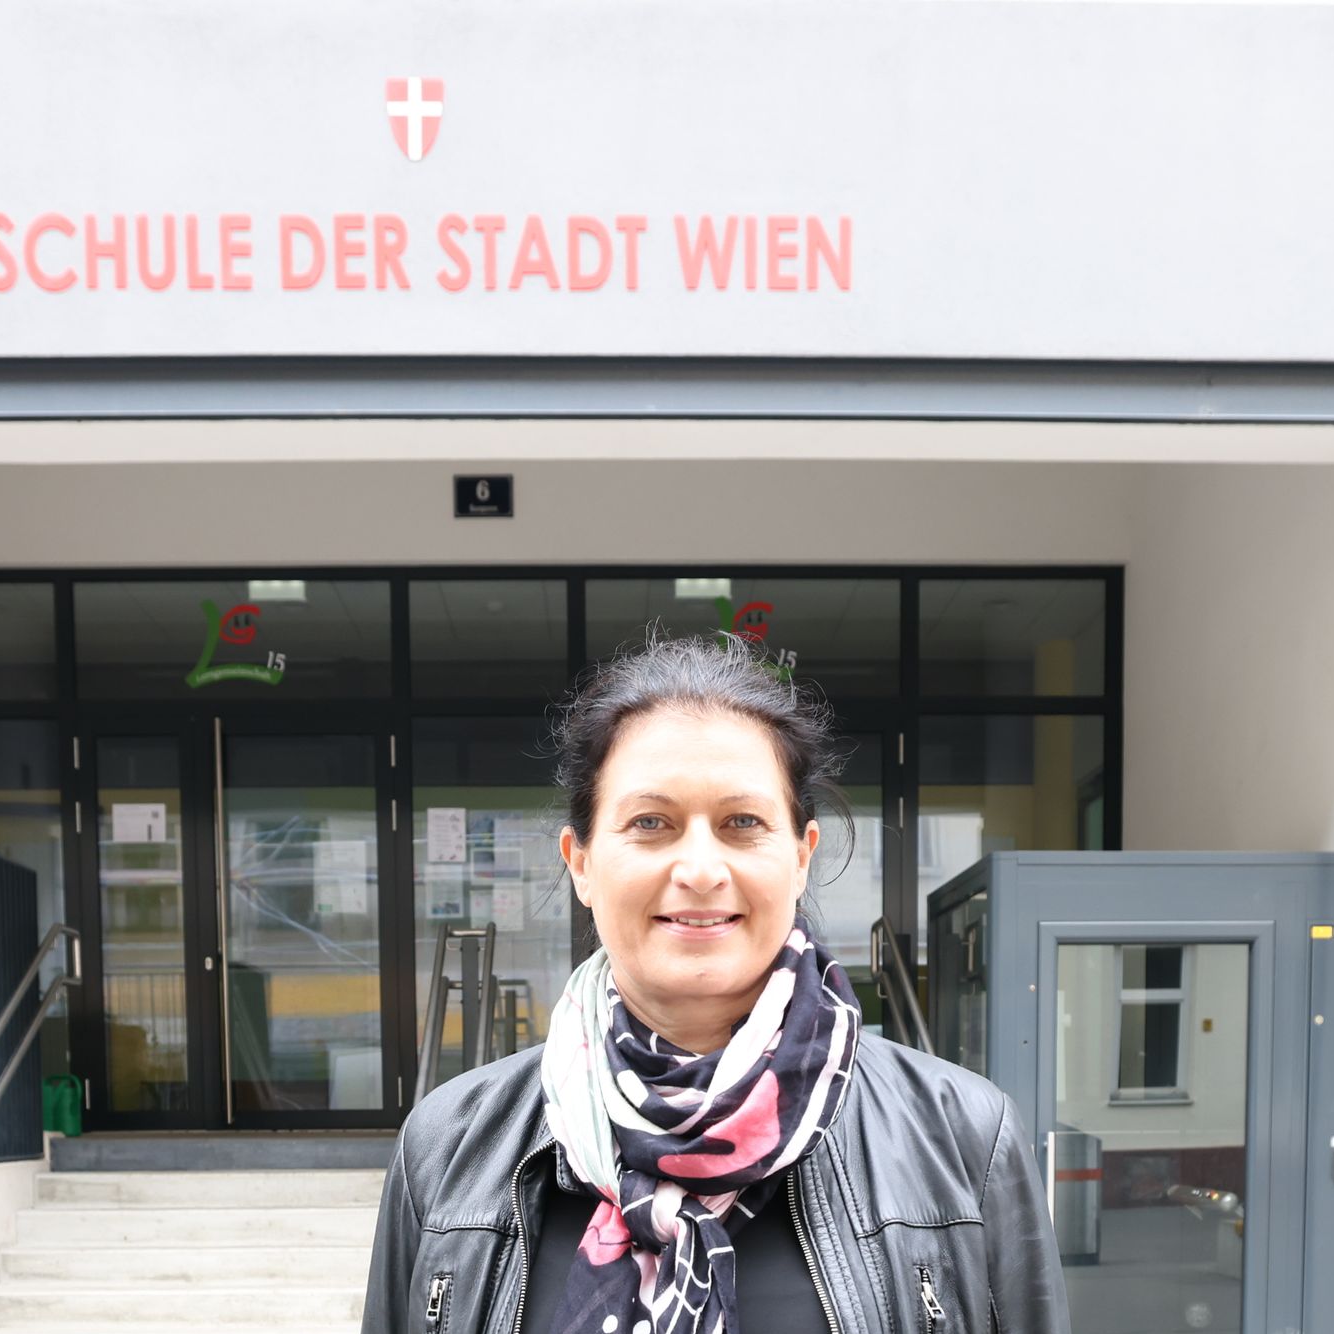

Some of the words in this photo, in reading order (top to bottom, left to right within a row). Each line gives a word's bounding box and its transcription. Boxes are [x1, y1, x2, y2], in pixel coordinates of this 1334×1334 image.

[279, 213, 411, 292] DER
[436, 213, 648, 292] STADT
[673, 214, 854, 292] WIEN
[475, 479, 490, 501] 6
[267, 651, 286, 673] 15
